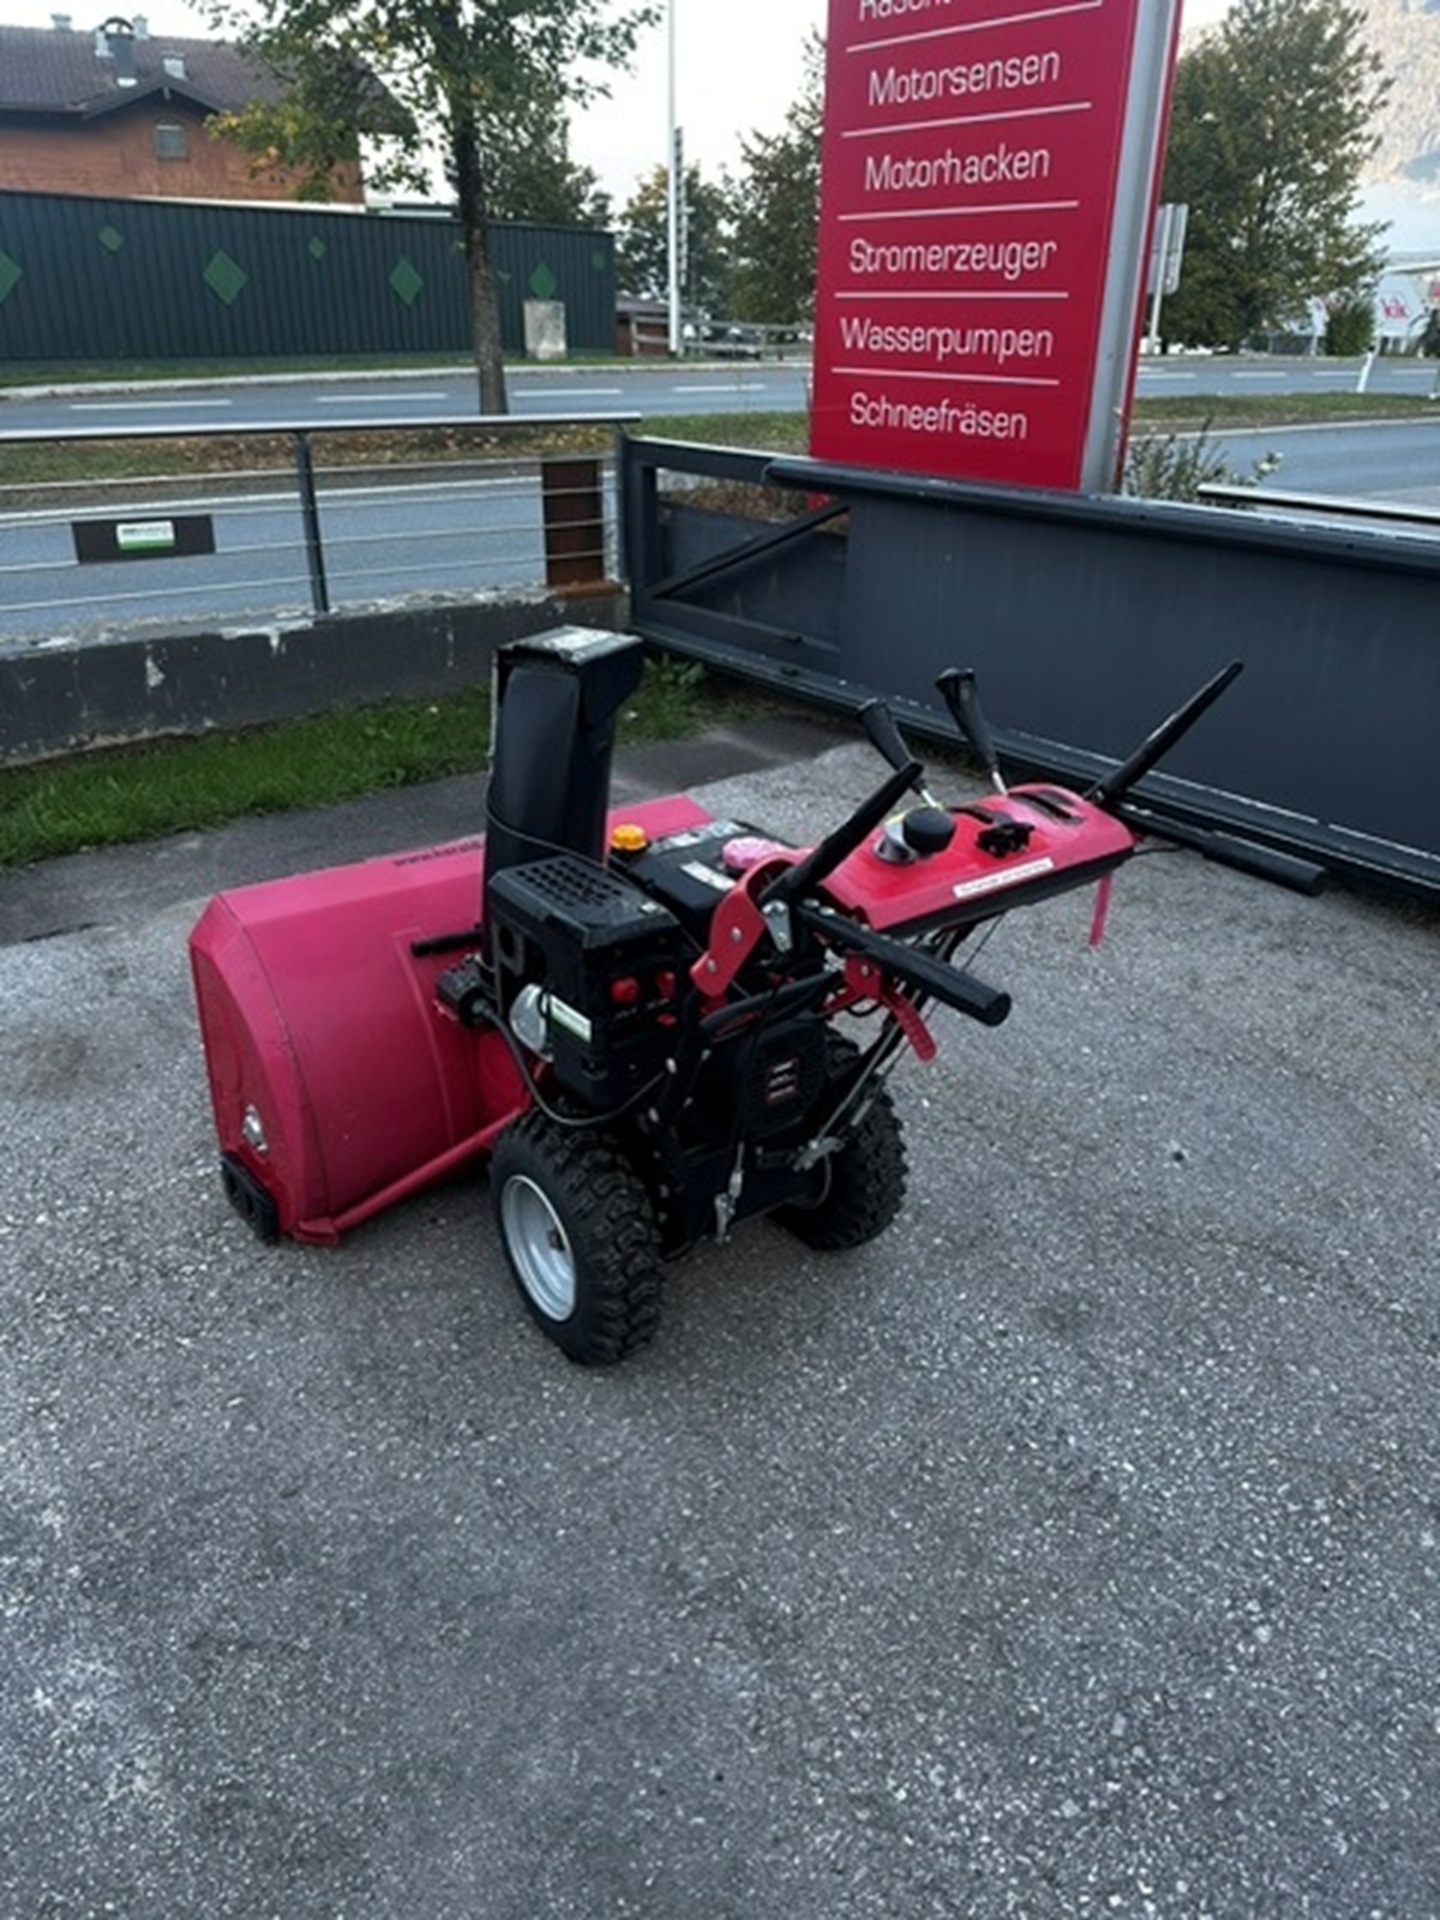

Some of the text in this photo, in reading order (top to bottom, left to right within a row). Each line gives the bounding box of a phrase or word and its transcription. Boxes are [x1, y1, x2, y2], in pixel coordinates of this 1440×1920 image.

[868, 51, 1060, 107] Motorsensen
[865, 143, 1050, 190] Motorhacken
[849, 238, 1057, 281] Stromerzeuger
[840, 317, 1052, 363] Wasserpumpen
[851, 392, 1028, 438] Schneefräsen
